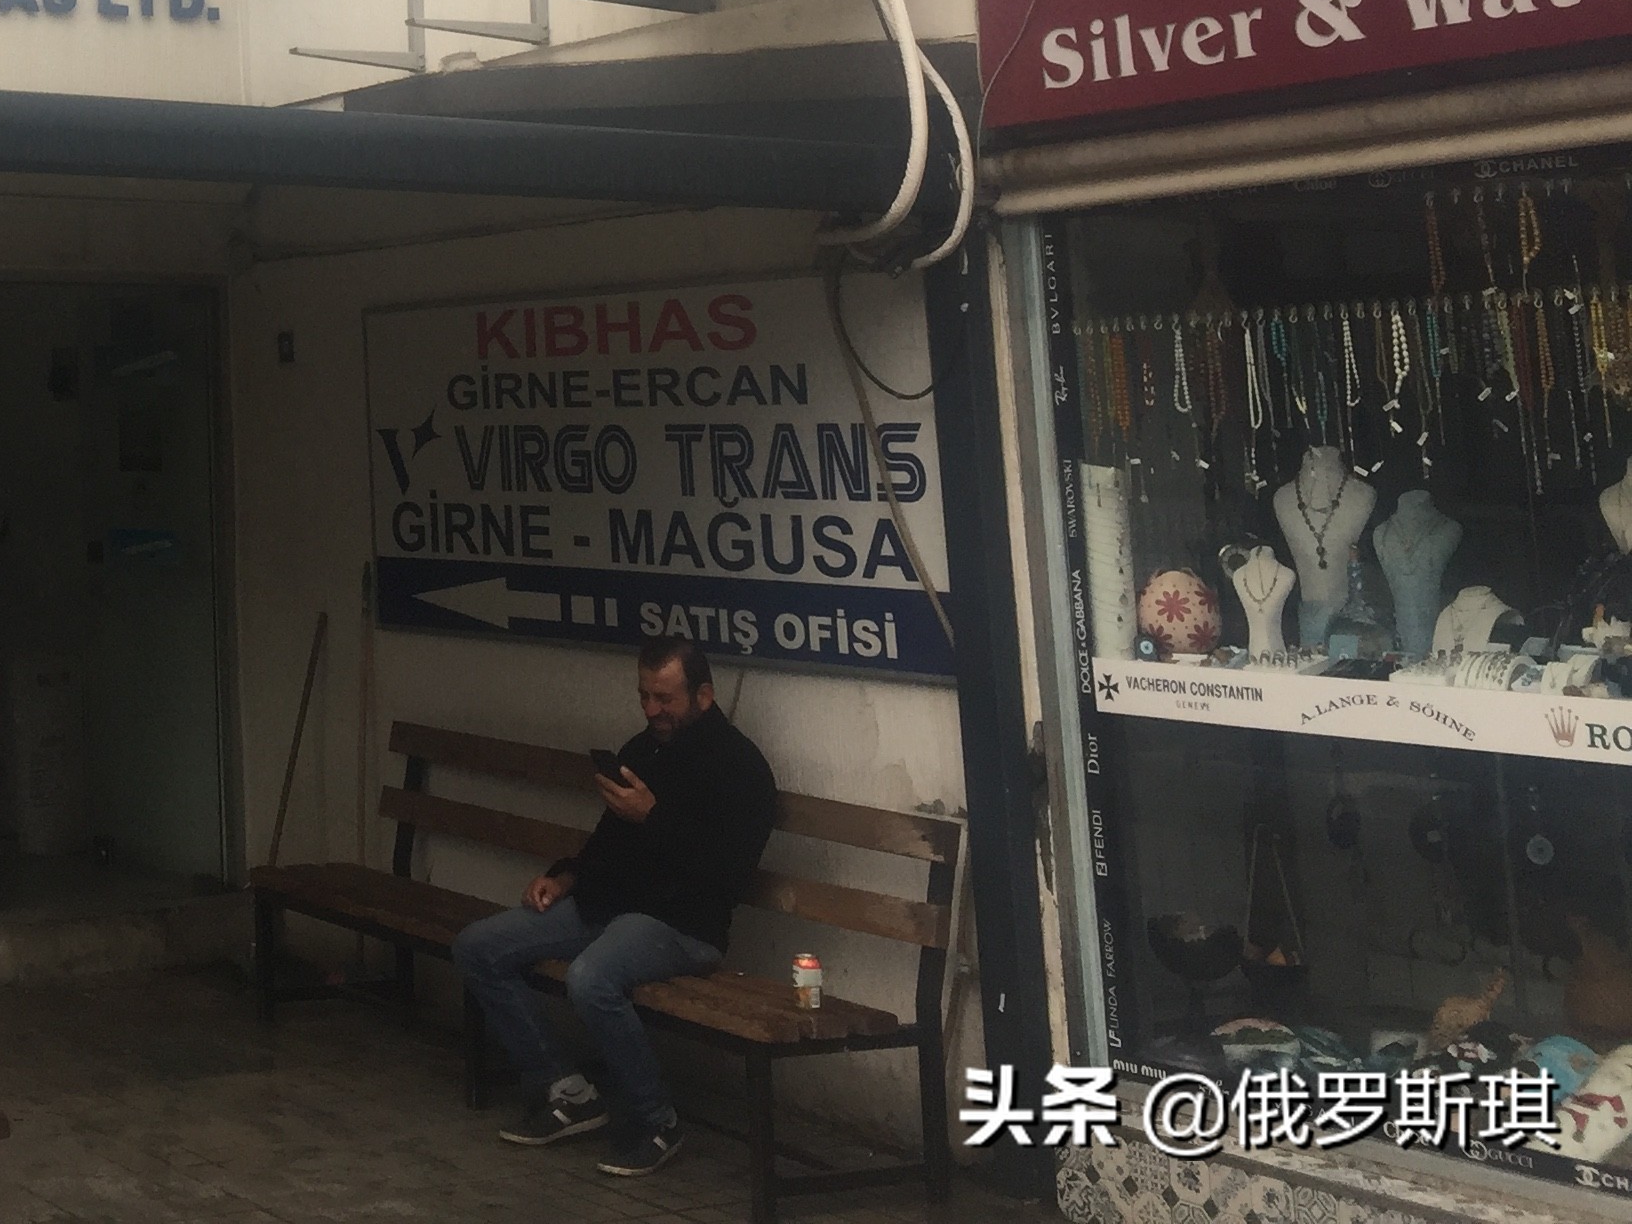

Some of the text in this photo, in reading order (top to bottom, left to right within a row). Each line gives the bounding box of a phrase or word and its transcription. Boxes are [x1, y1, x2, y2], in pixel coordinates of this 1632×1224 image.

[1041, 7, 1263, 89] Silver
[1499, 156, 1579, 173] CHANEL
[476, 294, 757, 360] KIBHAS
[454, 422, 927, 502] VIRGO TRANS
[1063, 459, 1078, 539] SWAROVSKI
[392, 489, 554, 559] GİRNE
[609, 494, 919, 582] MAĞUSA
[640, 601, 899, 659] SATIŞ OFİSİ
[1071, 569, 1087, 640] GABBANA
[1076, 649, 1092, 694] DOLCE
[1126, 676, 1264, 702] VACHERON CONSTANTIN
[1087, 733, 1100, 775] Dior
[1092, 809, 1105, 859] FENDI
[1487, 1149, 1533, 1169] GUCCI
